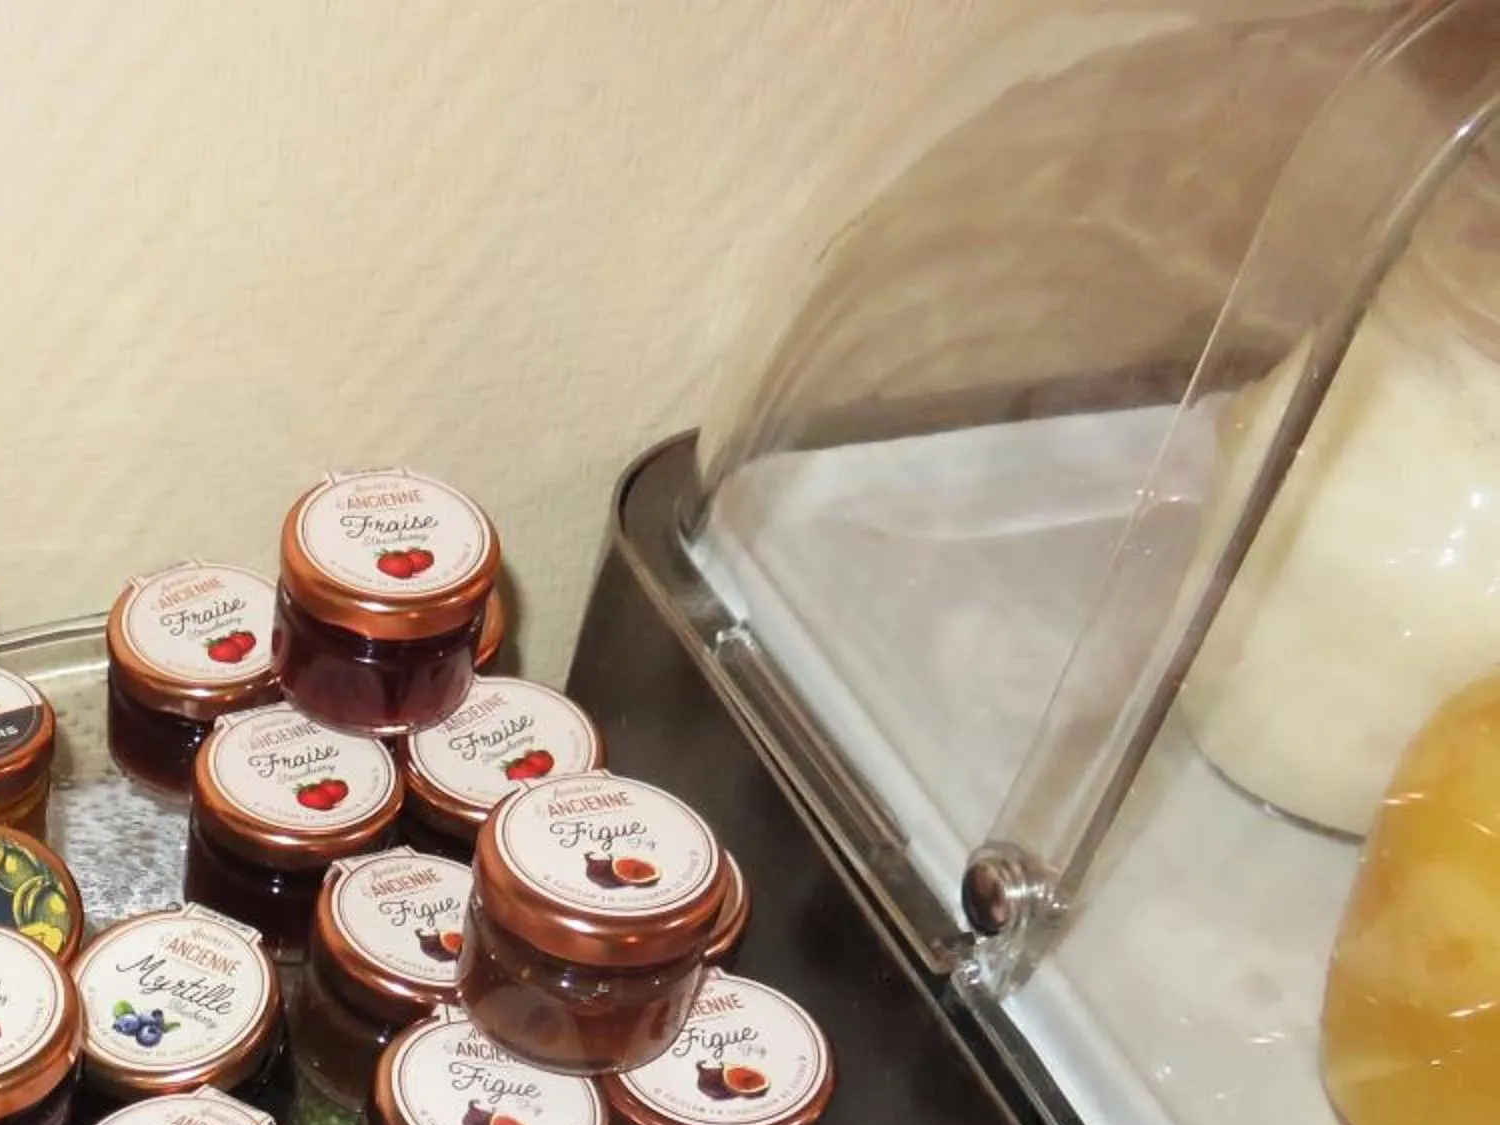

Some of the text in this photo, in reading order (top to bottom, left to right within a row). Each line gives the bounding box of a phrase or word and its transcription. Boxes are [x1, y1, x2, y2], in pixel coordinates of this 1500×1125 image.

[339, 513, 440, 539] Fraise
[160, 597, 247, 637] Fraise
[449, 713, 535, 761] Fraise
[247, 745, 340, 778] Fraise
[547, 791, 635, 818] ANCIENNE
[549, 820, 648, 850] Figue
[370, 867, 443, 898] ANCIENNE
[378, 897, 461, 927] Figue
[164, 937, 243, 977] ANCIENNE
[115, 953, 237, 1015] Myrtille
[688, 993, 745, 1019] IENNE
[672, 1025, 760, 1060] Figue
[449, 1060, 542, 1105] Figue
